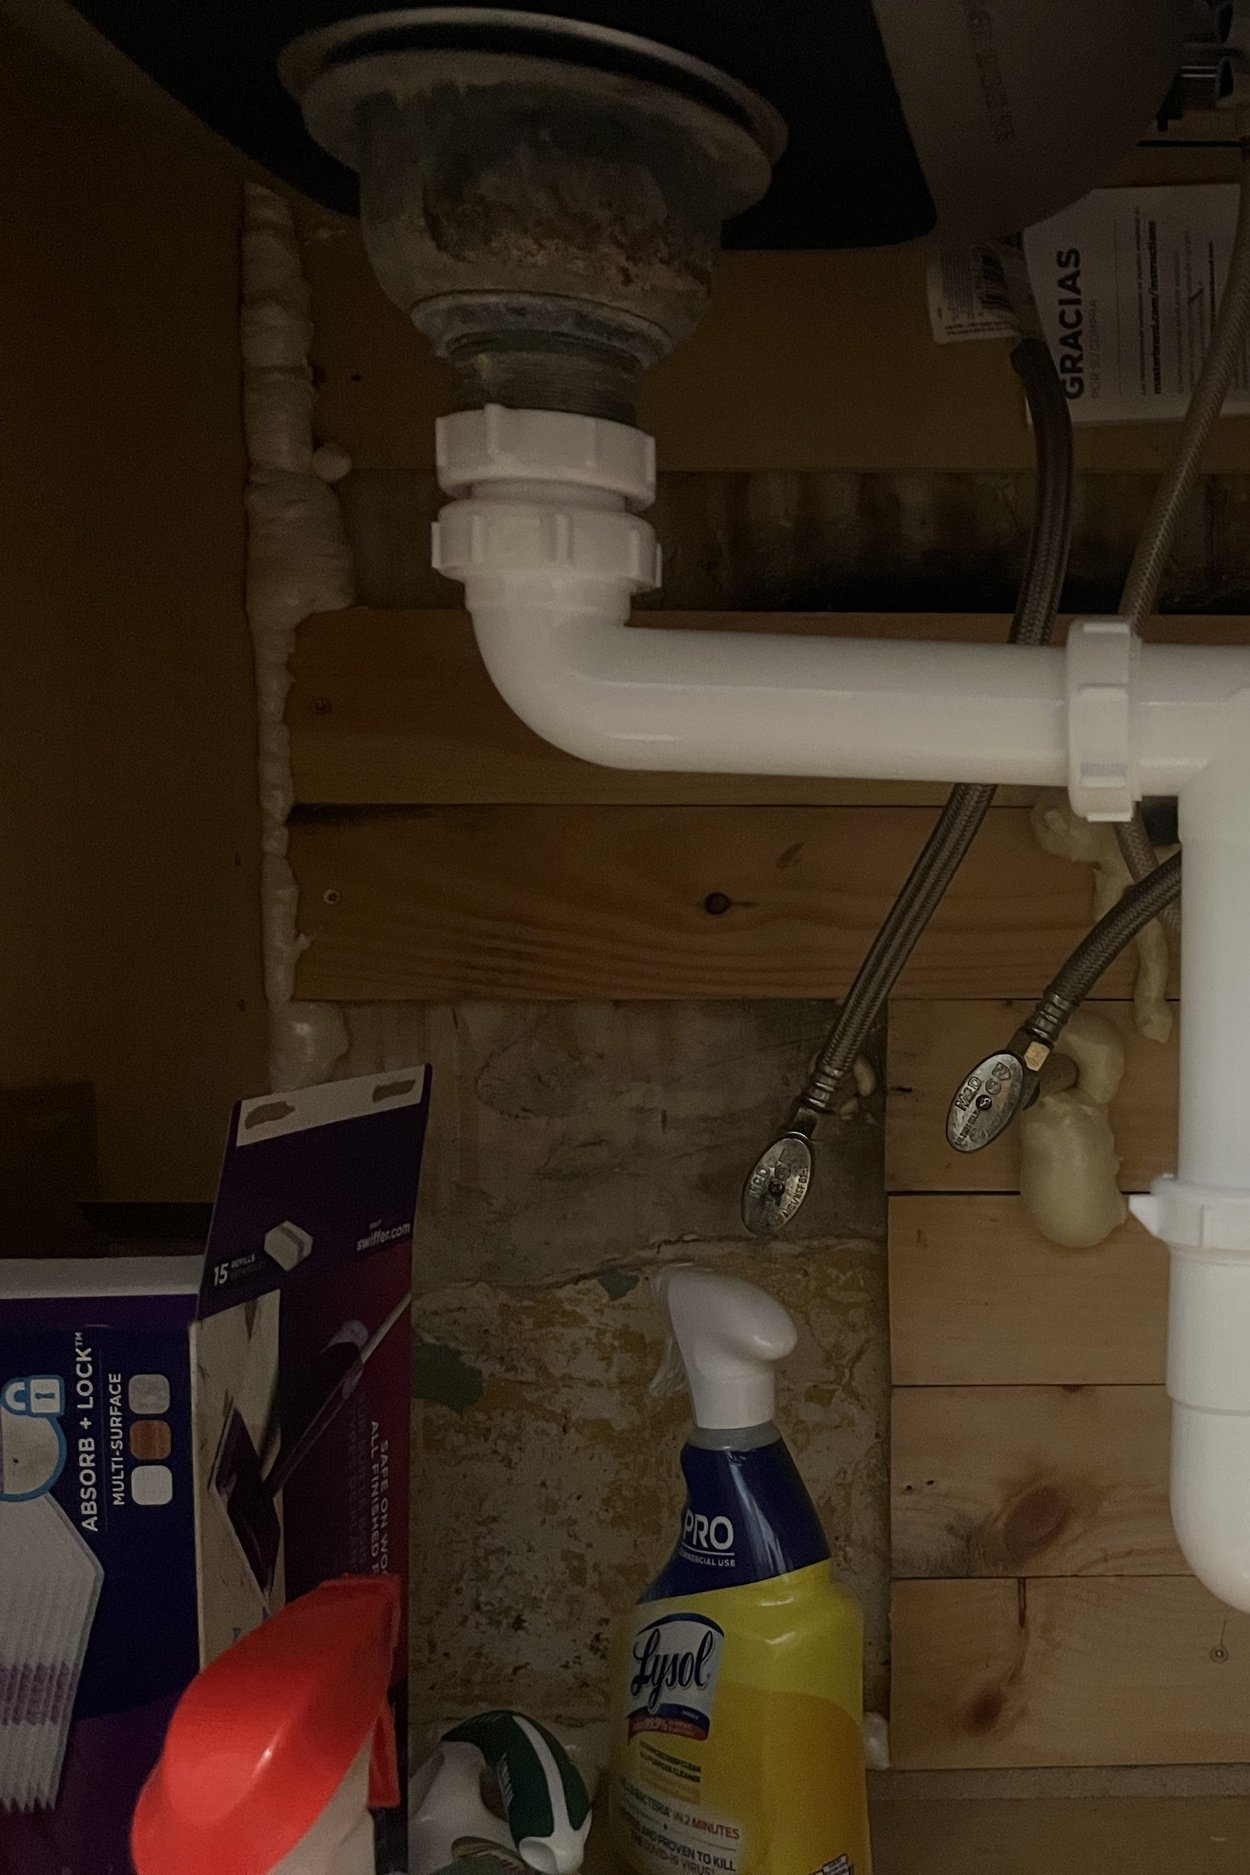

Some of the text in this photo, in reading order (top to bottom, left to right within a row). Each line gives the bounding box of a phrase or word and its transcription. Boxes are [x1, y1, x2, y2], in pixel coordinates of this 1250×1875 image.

[1056, 247, 1084, 400] GRACIAS
[1088, 299, 1099, 351] COMPRA
[1147, 220, 1162, 394] masterbrand.com/instructions
[355, 1222, 411, 1251] swiffer.com
[213, 1262, 229, 1287] 15
[79, 1417, 93, 1429] +
[108, 1372, 126, 1506] MULTI-SURFACE
[371, 1421, 379, 1459] ALL
[78, 1437, 99, 1532] ABSORB
[380, 1439, 389, 1494] SAFE
[371, 1463, 379, 1557] FINISHED
[380, 1497, 389, 1528] ON
[683, 1508, 735, 1551] PRO
[718, 1558, 736, 1567] USE
[631, 1628, 713, 1711] Lysol
[692, 1817, 741, 1840] MINUTES
[657, 1833, 695, 1860] PROVEN
[696, 1851, 711, 1865] TO
[713, 1855, 736, 1872] KILL
